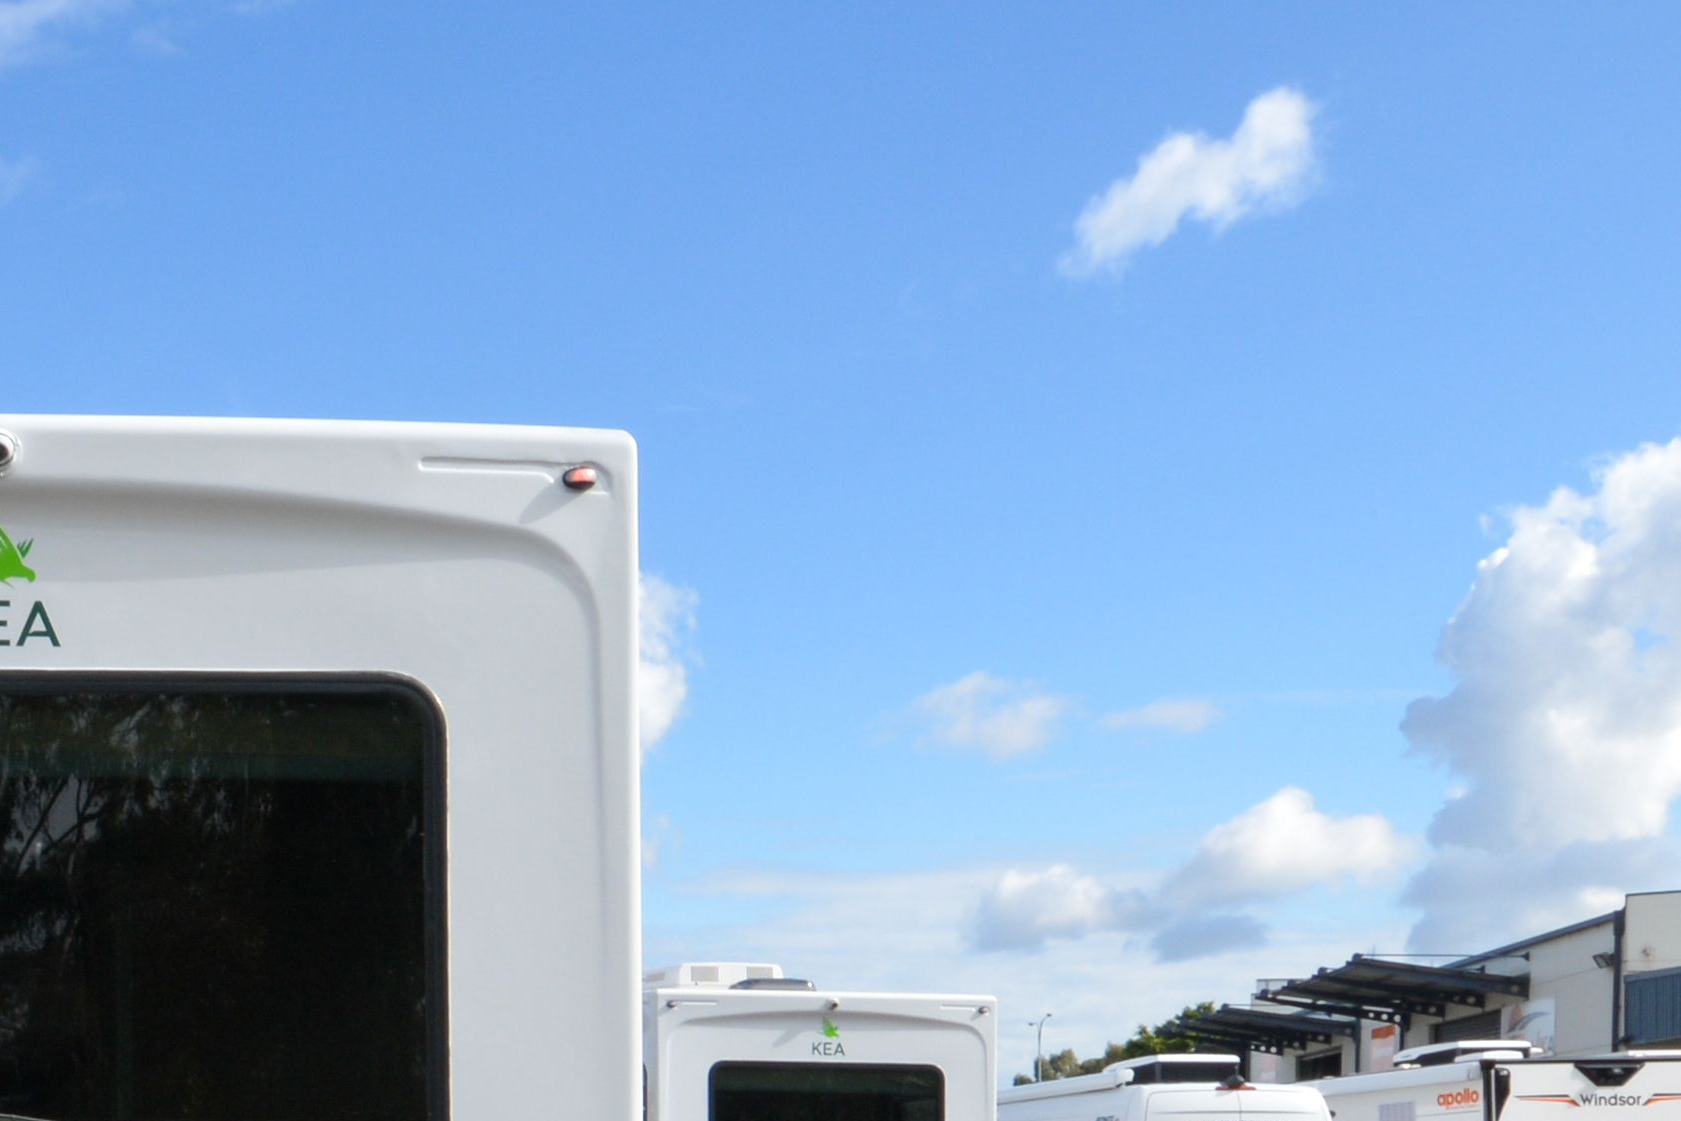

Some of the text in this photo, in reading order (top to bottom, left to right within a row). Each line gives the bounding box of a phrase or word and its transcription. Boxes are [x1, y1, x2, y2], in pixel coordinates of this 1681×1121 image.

[811, 1041, 846, 1056] KEA
[1437, 1088, 1480, 1110] apollo
[1579, 1093, 1642, 1107] Windsor
